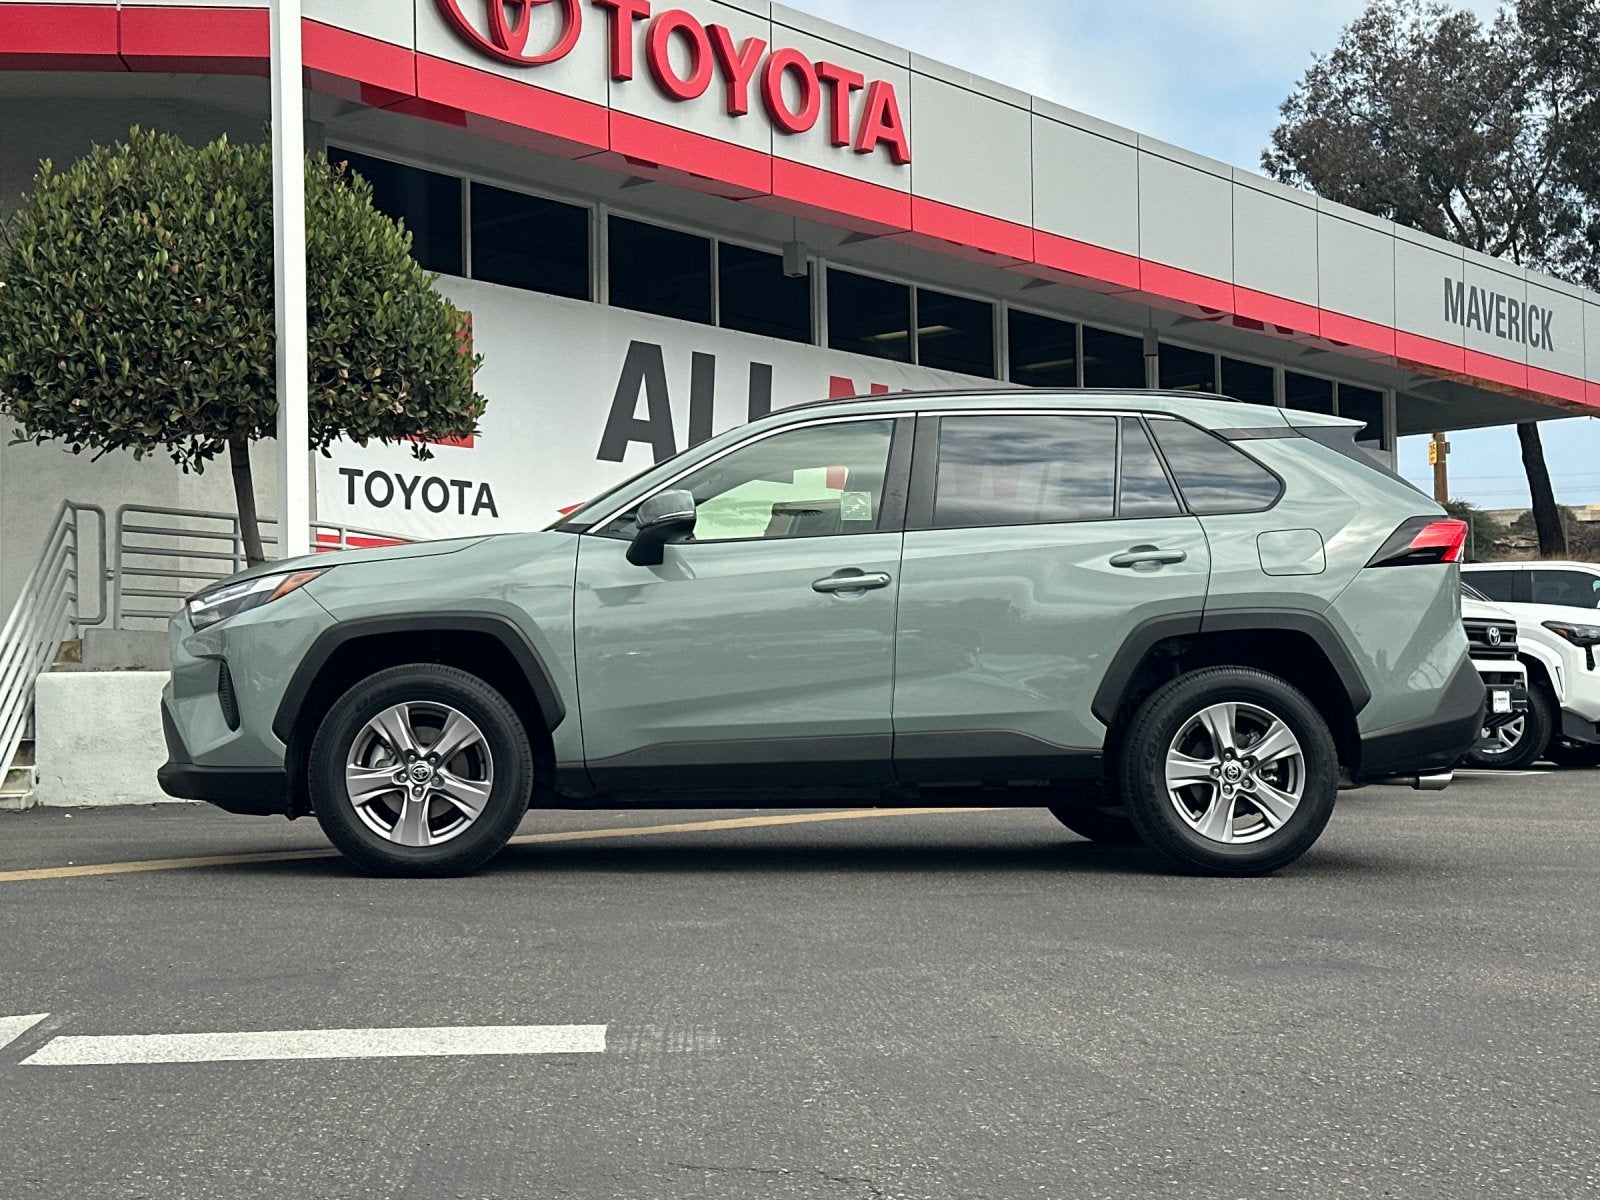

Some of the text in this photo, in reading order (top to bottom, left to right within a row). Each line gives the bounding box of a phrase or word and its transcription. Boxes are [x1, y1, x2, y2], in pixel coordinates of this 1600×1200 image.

[592, 0, 911, 165] TOYOTA
[1443, 277, 1554, 352] MAVERICK
[338, 467, 499, 518] TOYOTA
